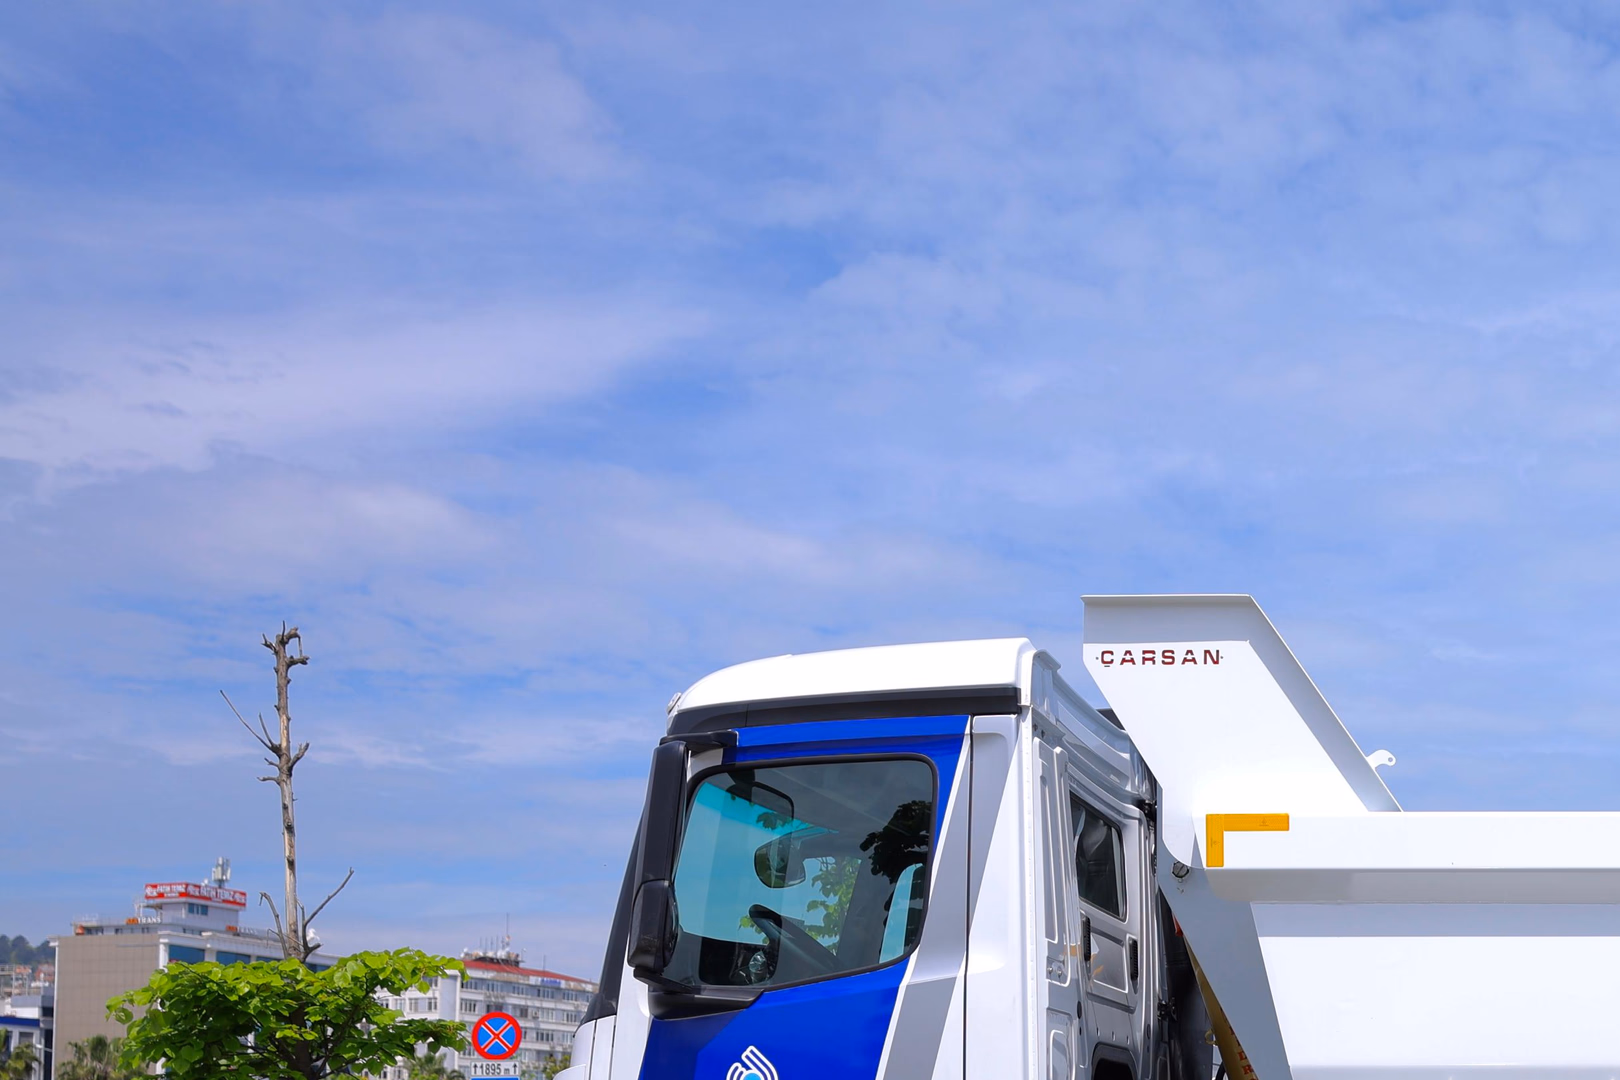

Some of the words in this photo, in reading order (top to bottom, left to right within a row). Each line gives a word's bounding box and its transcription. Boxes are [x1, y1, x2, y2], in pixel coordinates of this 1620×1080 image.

[1100, 649, 1220, 668] ÇARSAN
[480, 1063, 502, 1075] 1895
[504, 1067, 510, 1075] m
